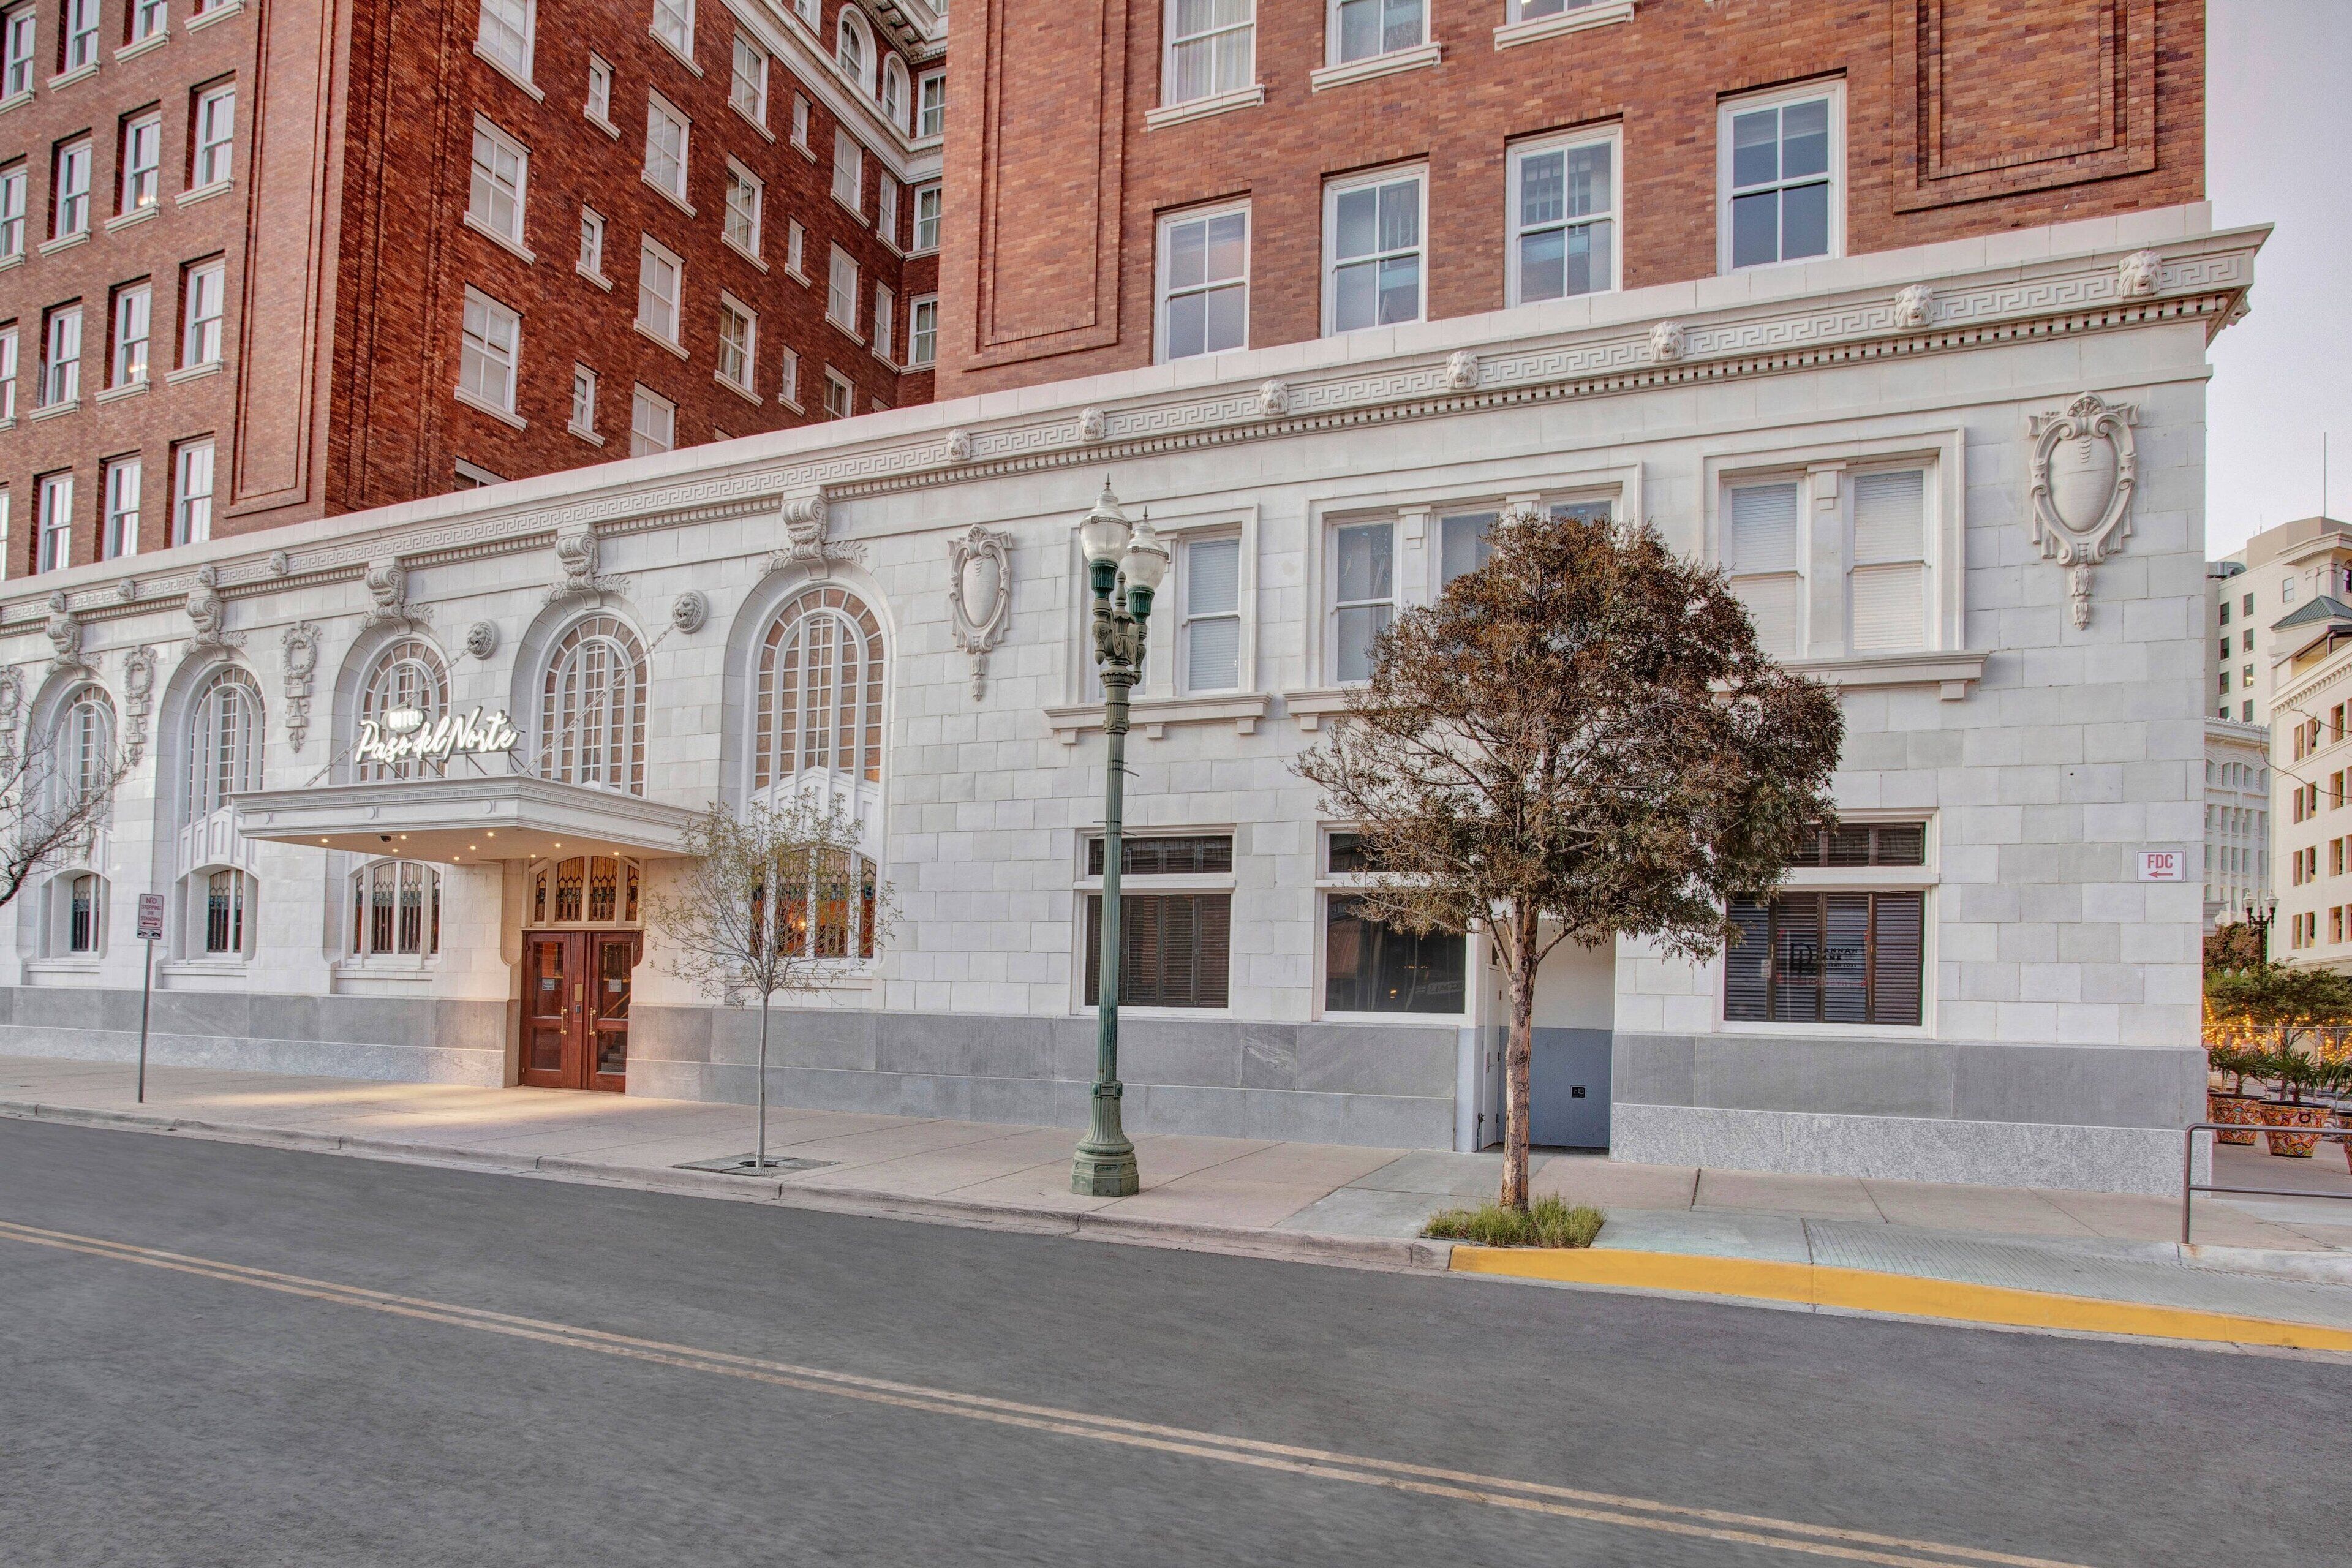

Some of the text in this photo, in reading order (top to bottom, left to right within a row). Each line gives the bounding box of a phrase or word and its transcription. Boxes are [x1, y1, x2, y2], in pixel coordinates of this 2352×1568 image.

[355, 706, 520, 763] Paso del Norte
[2147, 854, 2173, 869] FDC
